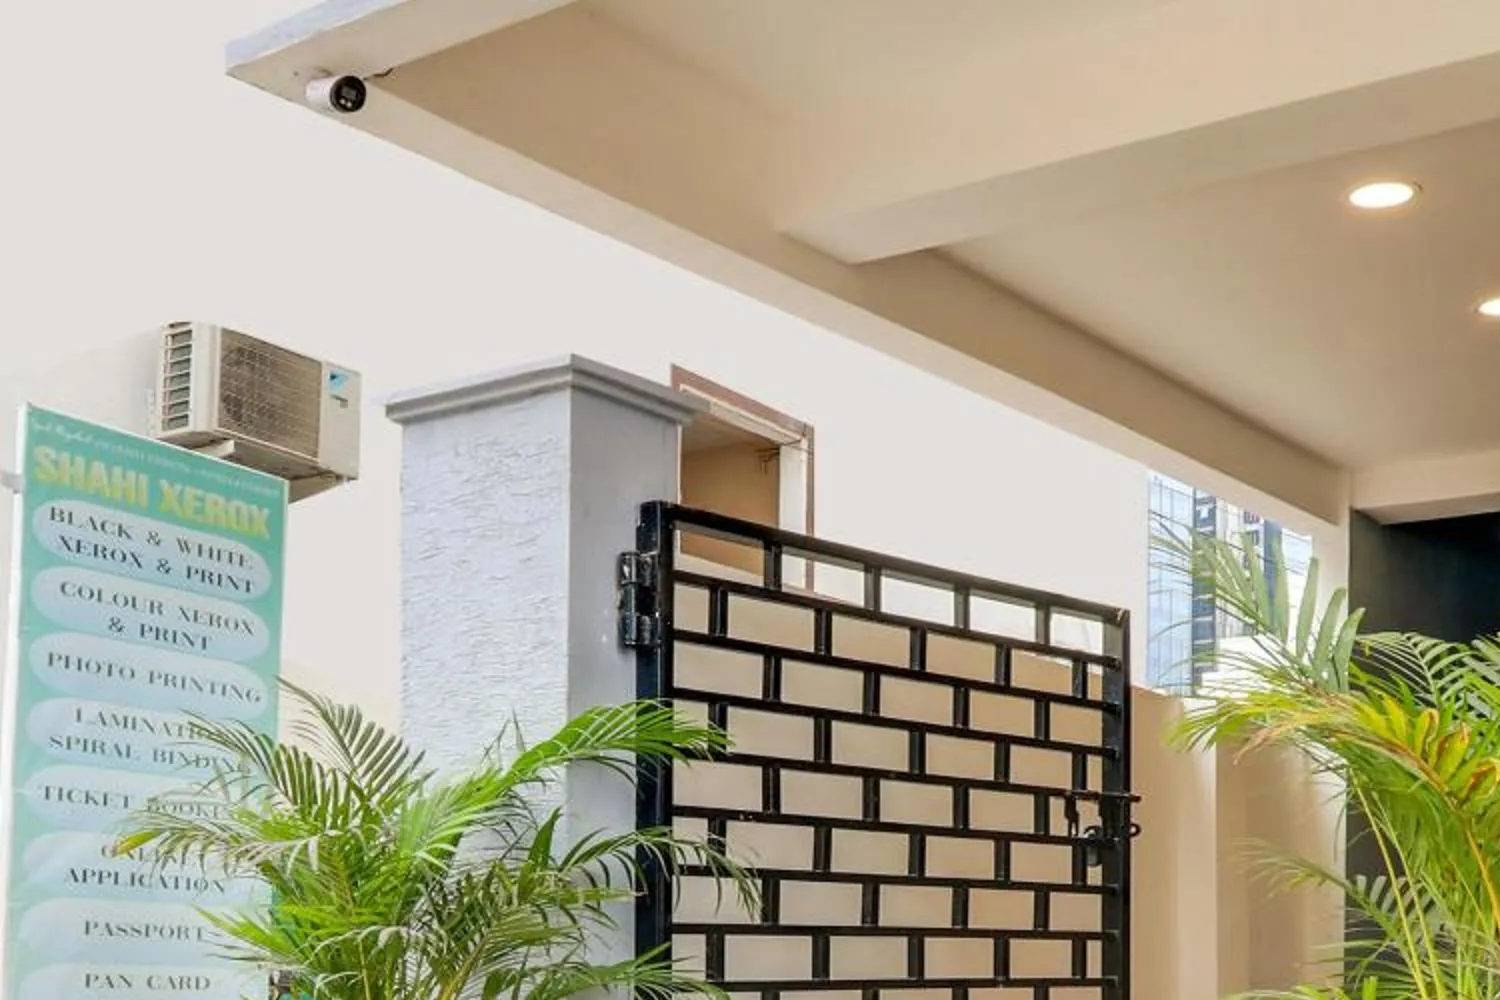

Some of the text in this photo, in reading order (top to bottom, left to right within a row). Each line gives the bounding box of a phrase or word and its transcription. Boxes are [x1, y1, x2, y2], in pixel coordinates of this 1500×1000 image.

[33, 445, 148, 510] SHAHI
[159, 480, 271, 540] XEROX
[49, 506, 253, 569] BLACK & WHITE
[58, 535, 255, 594] XEROX & PRINT
[59, 580, 255, 636] COLOUR XEROX
[108, 617, 212, 650] & PRINT
[47, 651, 262, 703] PHOTO PRINTING
[49, 735, 140, 760] SPIRAL
[41, 785, 134, 810] TICKET
[65, 867, 226, 894] APPLICATION
[84, 973, 211, 992] PAN CARD
